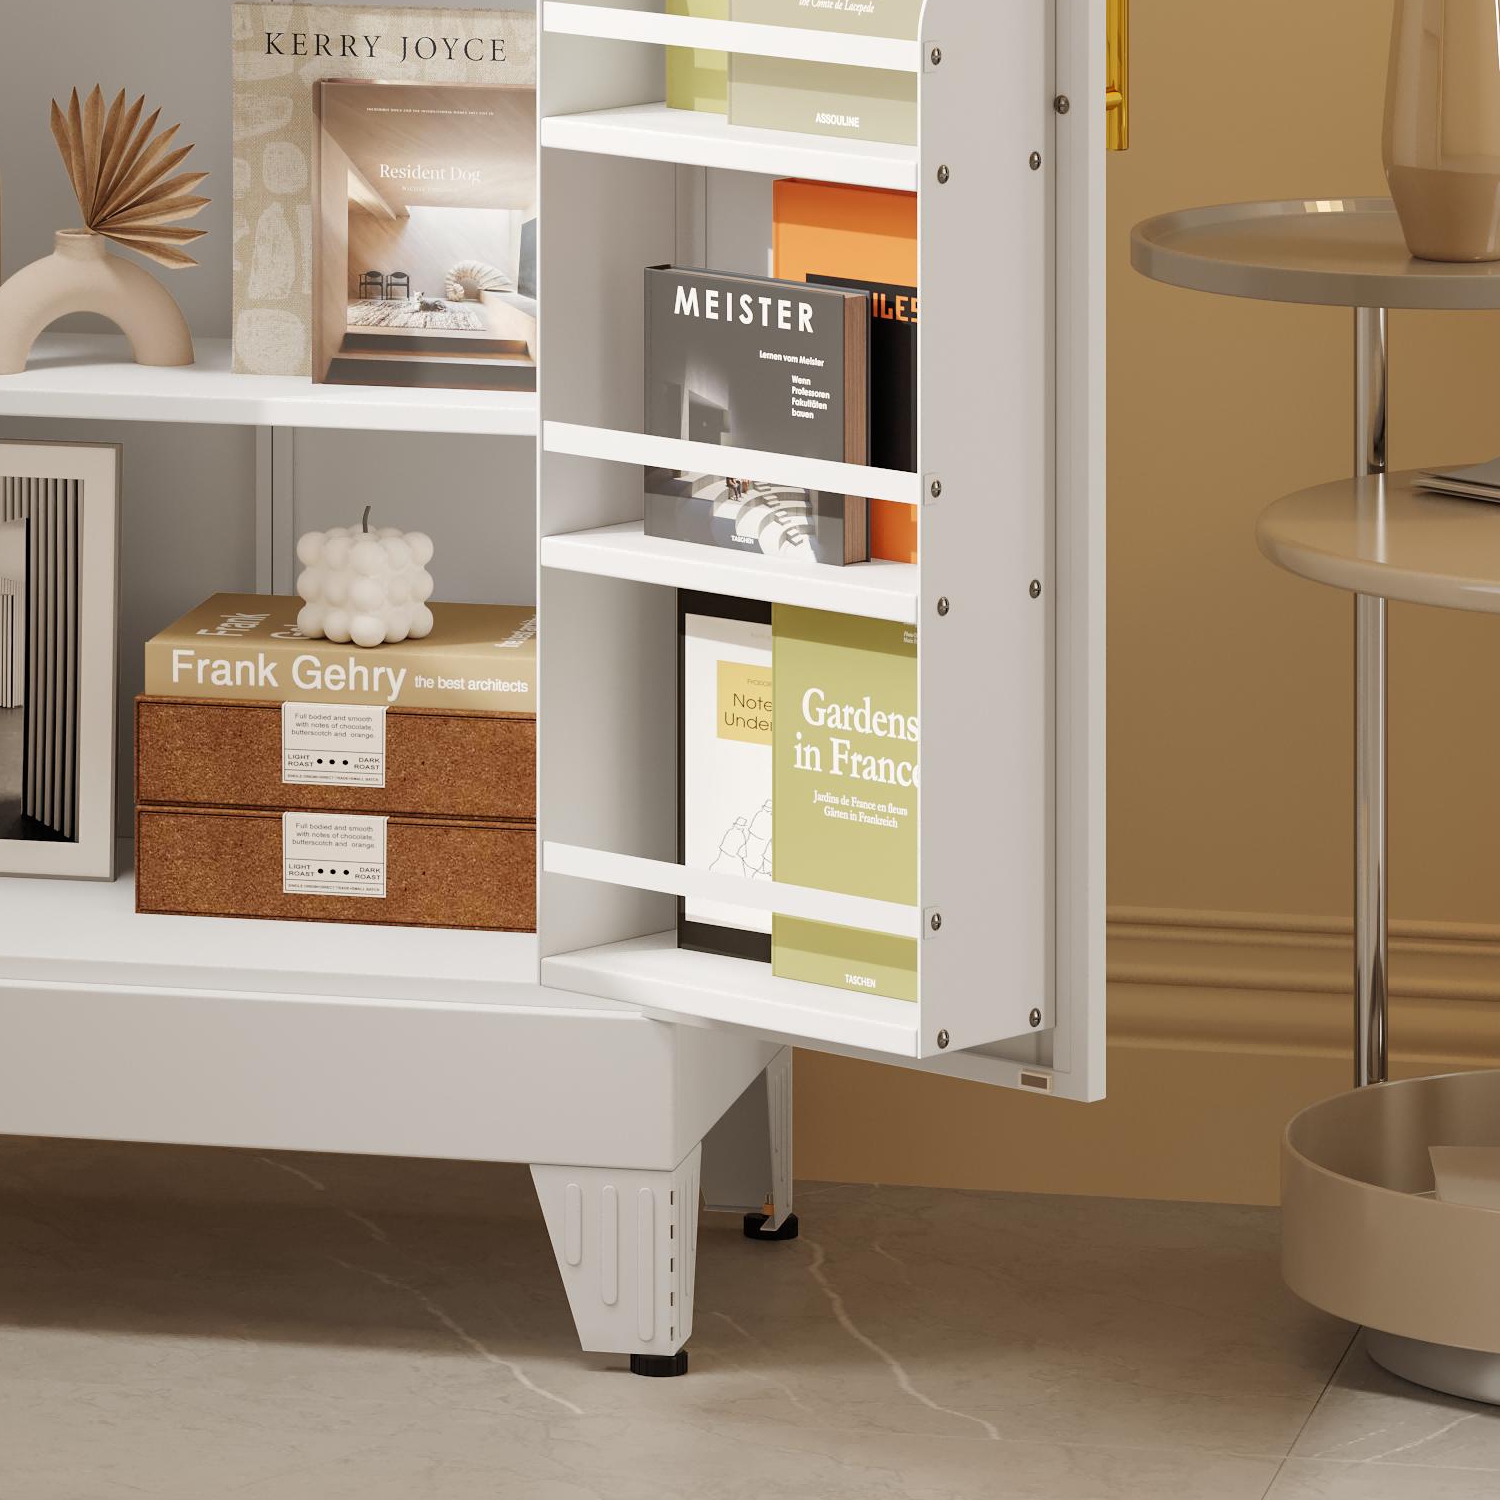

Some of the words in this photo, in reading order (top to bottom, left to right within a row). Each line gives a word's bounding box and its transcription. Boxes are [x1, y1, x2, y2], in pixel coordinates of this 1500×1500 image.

[265, 32, 382, 59] KERRY
[401, 35, 508, 63] JOYCE
[815, 112, 860, 128] ASSOULINE
[380, 164, 446, 180] Resident
[450, 166, 482, 186] Dog
[674, 285, 815, 334] MEISTER
[759, 350, 783, 362] Lernen
[783, 354, 798, 364] vom
[799, 355, 825, 367] Meister
[791, 374, 811, 386] Wenn
[791, 386, 831, 400] Professoren
[791, 396, 828, 411] Fakultäten
[791, 407, 815, 420] bauen
[731, 534, 754, 545] TASCHEN
[196, 612, 271, 637] Frank
[171, 649, 278, 688] Frank
[291, 653, 407, 702] Gehry
[414, 675, 434, 689] the
[437, 676, 465, 690] best
[467, 678, 529, 693] architects
[733, 693, 773, 712] Note
[802, 687, 918, 742] Gardens
[793, 732, 822, 774] in
[813, 789, 839, 804] Jardins
[840, 794, 850, 806] de
[851, 796, 877, 811] France
[877, 803, 887, 813] en
[824, 805, 848, 820] Gärten
[849, 809, 857, 821] in
[858, 811, 898, 828] Frankreich
[844, 973, 876, 989] TASCHEN
